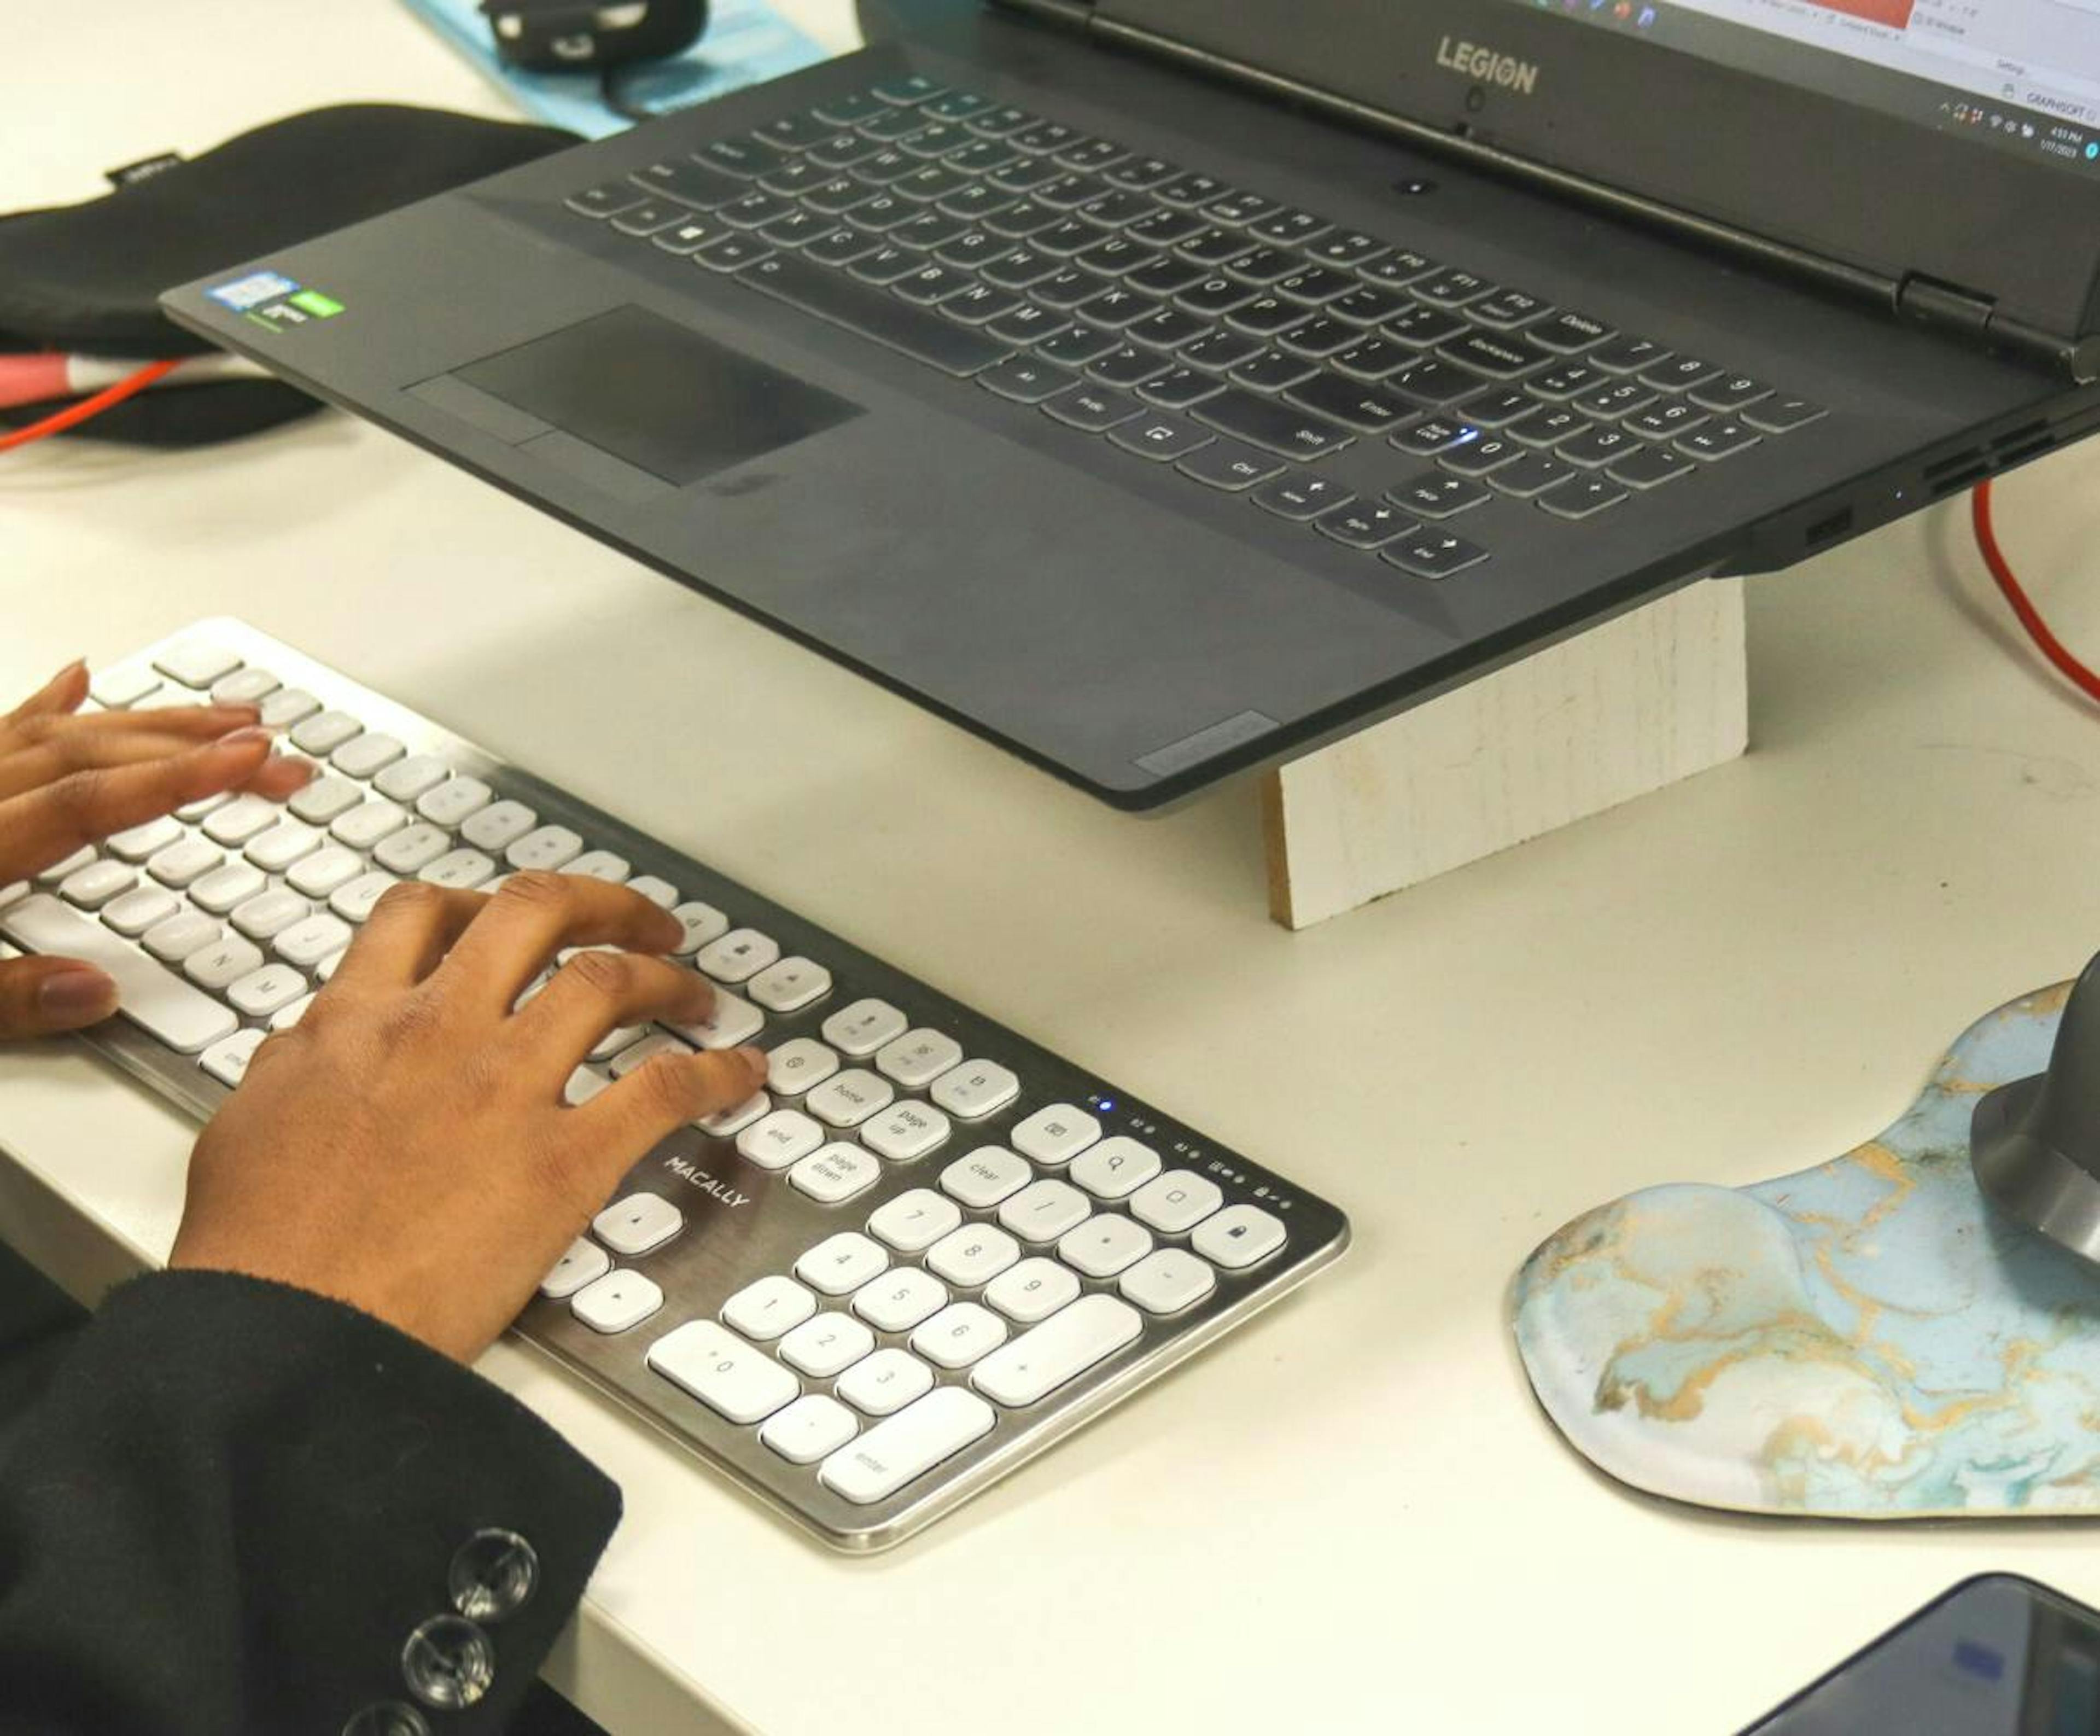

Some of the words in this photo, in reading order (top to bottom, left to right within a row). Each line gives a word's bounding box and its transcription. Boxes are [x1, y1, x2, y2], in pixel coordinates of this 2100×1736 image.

[1436, 36, 1538, 94] LEGION
[962, 235, 985, 246] G
[1104, 240, 1128, 252] U
[1103, 291, 1129, 304] K
[1254, 299, 1278, 309] P
[1679, 360, 1702, 371] 8
[1730, 378, 1752, 390] 9
[1613, 386, 1637, 398] 5
[1665, 406, 1687, 418] 6
[1547, 413, 1571, 426] 2
[1596, 433, 1620, 445] 3
[833, 1084, 865, 1103] home
[899, 1109, 928, 1129] page
[889, 1123, 907, 1136] up
[767, 1128, 792, 1145] end
[829, 1154, 858, 1173] page
[811, 1162, 842, 1182] down
[663, 1156, 750, 1208] MACALLY
[905, 1209, 925, 1220] 7
[964, 1244, 983, 1258] 8
[835, 1254, 852, 1265] 4
[1023, 1279, 1042, 1292] 9
[891, 1289, 911, 1302] 5
[764, 1298, 779, 1309] 1
[950, 1324, 970, 1337] 6
[818, 1334, 837, 1347] 2
[876, 1371, 895, 1385] 3
